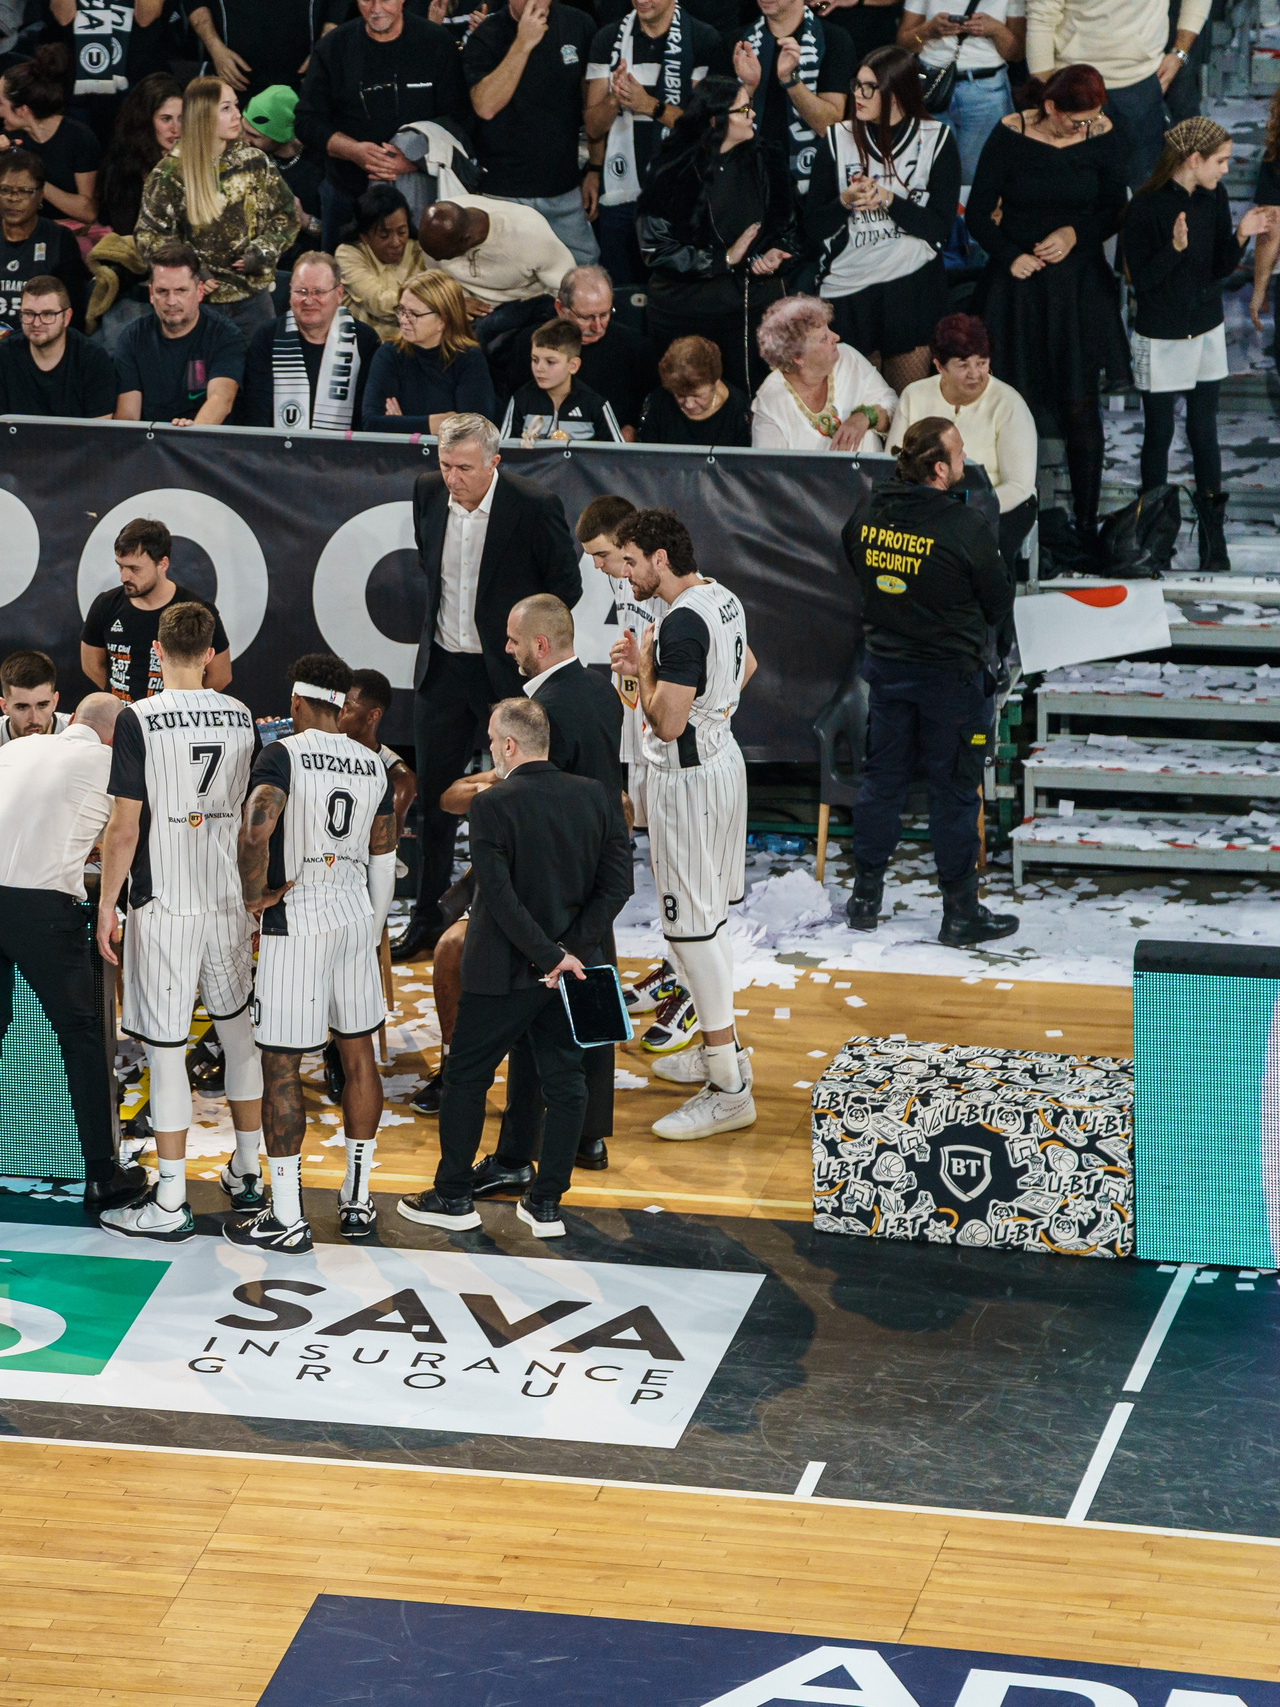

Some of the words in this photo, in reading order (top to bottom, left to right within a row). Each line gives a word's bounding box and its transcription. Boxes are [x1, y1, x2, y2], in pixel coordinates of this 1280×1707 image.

[664, 60, 682, 106] IUBIR
[329, 351, 353, 401] CLUJ
[877, 529, 934, 556] PROTECT
[865, 548, 922, 575] SECURITY
[146, 710, 252, 733] KULVIETIS
[189, 742, 225, 798] 7
[301, 753, 378, 778] GUZMAN
[323, 787, 358, 841] 0
[663, 893, 679, 923] 8
[943, 1103, 996, 1124] U-BT
[817, 1158, 868, 1181] U-BT
[951, 1157, 981, 1177] BT
[1048, 1174, 1101, 1195] U-BT
[993, 1222, 1044, 1246] U-BT
[215, 1278, 686, 1362] SAVA
[202, 1336, 675, 1387] INSURANCE
[187, 1356, 665, 1406] GROUP
